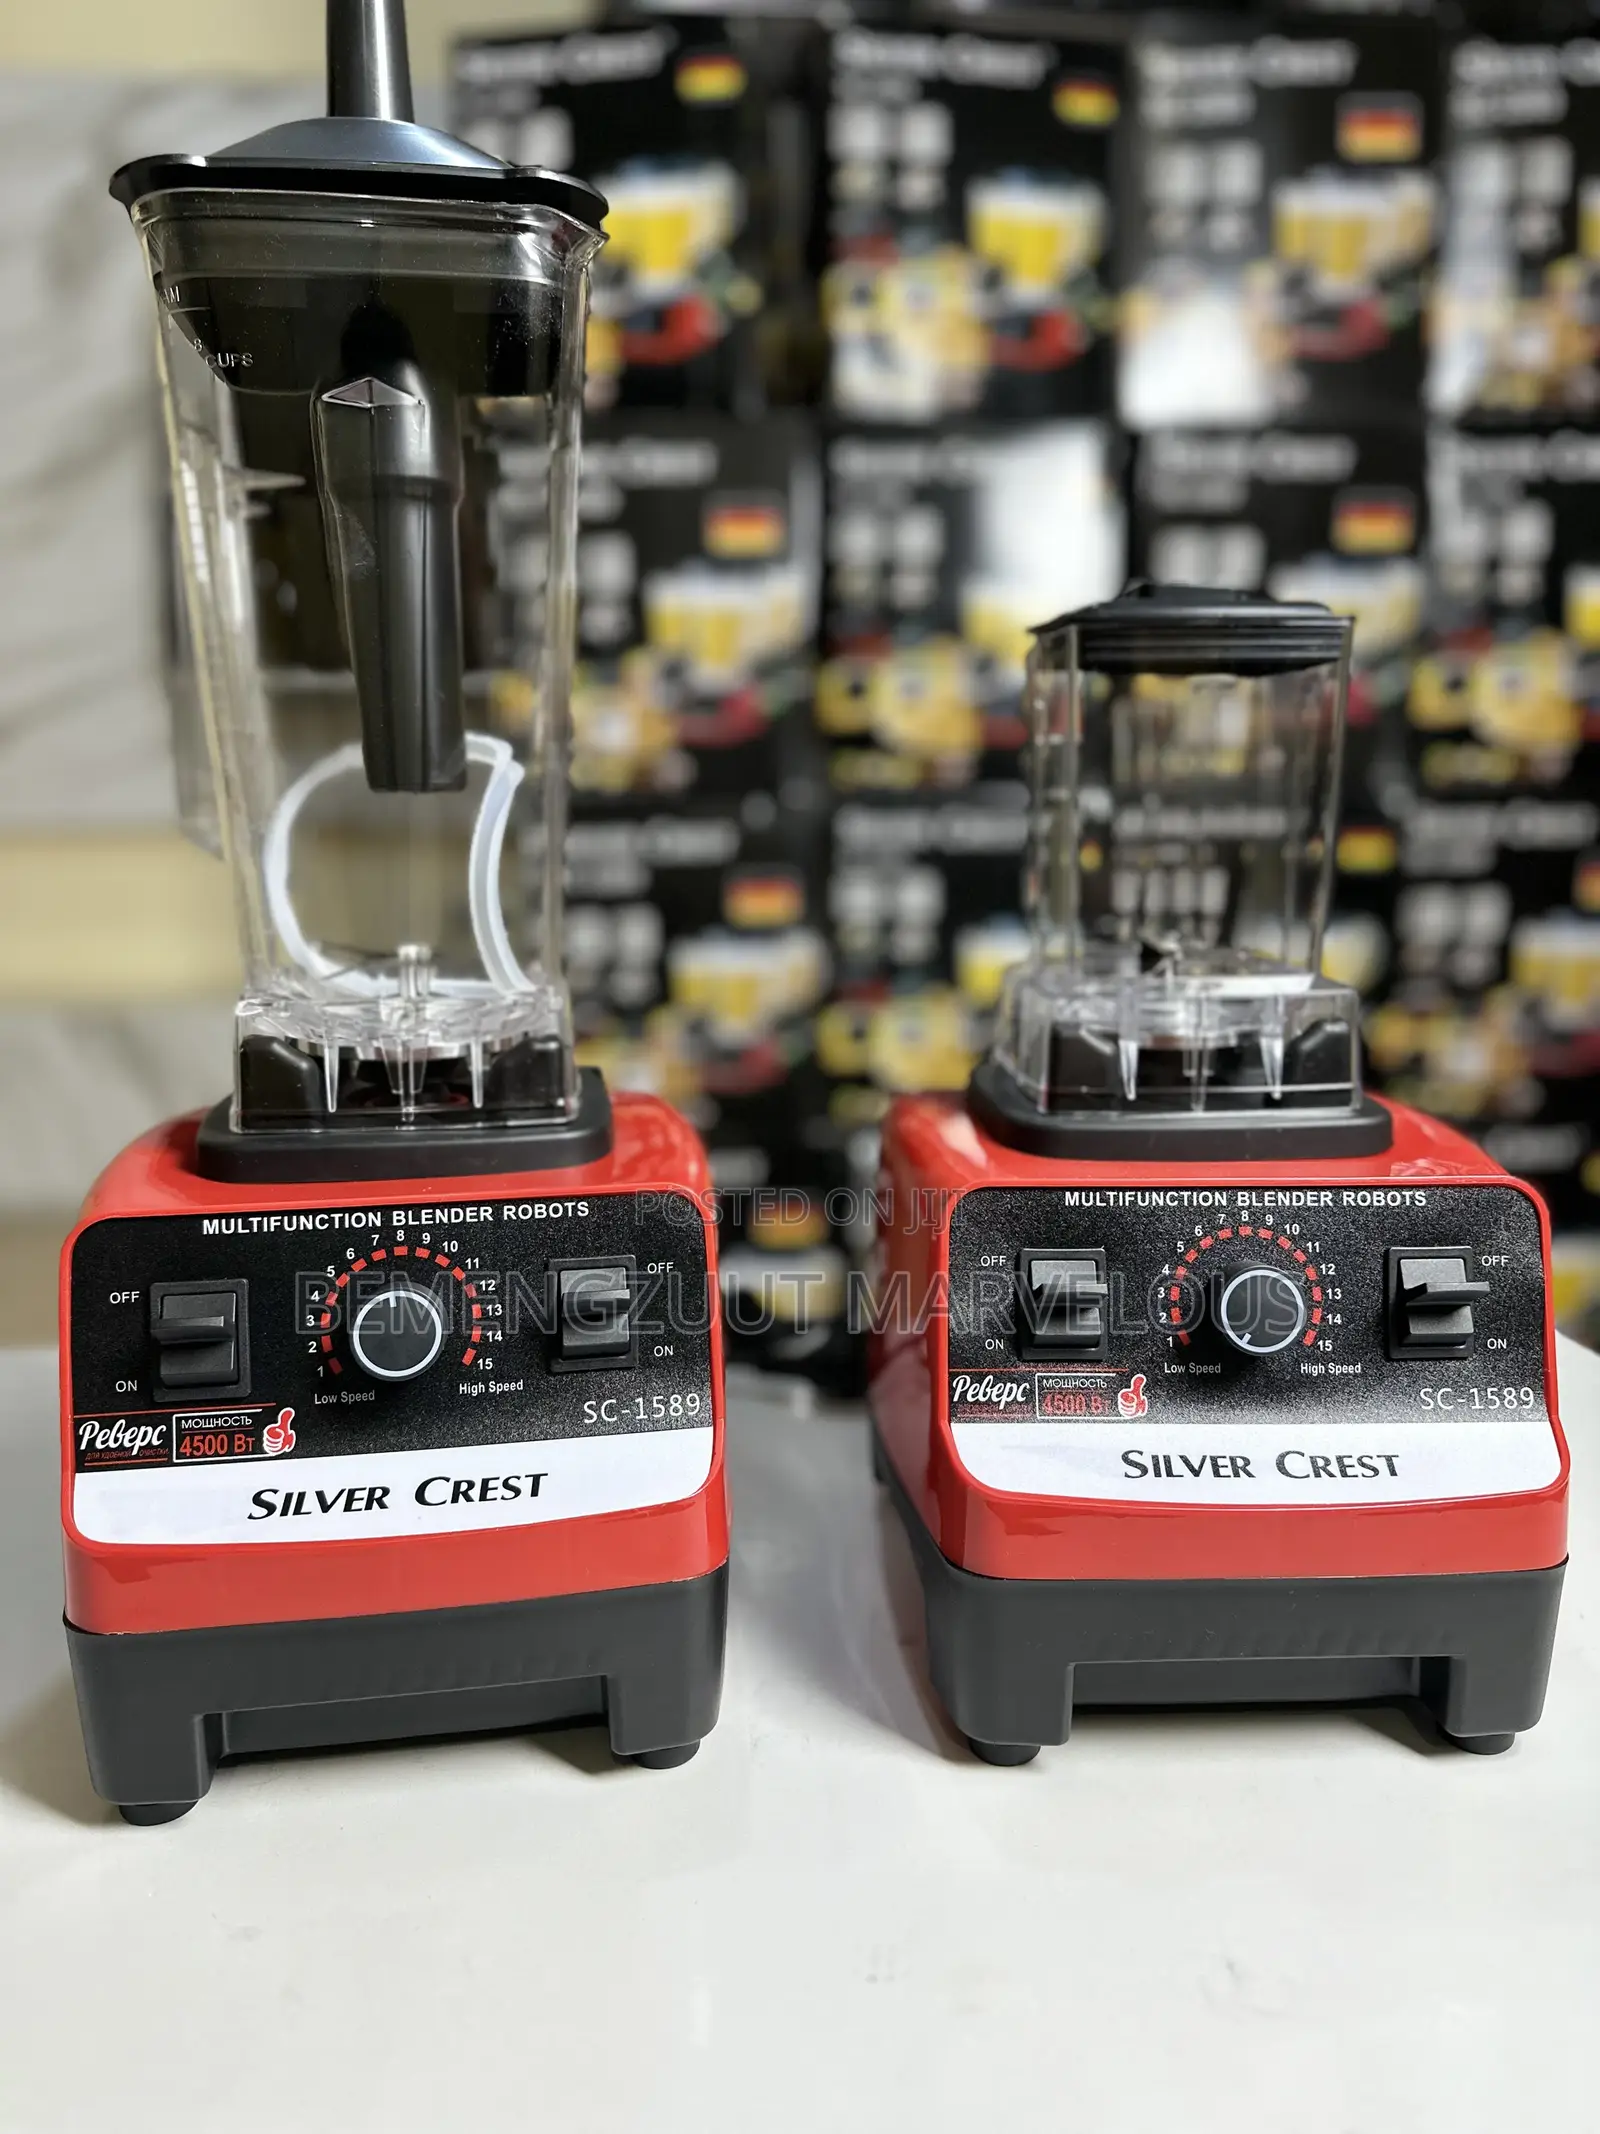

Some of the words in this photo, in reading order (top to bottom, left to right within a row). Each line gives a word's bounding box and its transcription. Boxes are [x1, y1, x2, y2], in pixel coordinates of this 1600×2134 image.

[194, 338, 203, 352] 8
[205, 352, 254, 368] CUPS
[1064, 1190, 1228, 1207] MULTIFUNCTION
[1236, 1190, 1334, 1207] BLENDER
[1342, 1190, 1427, 1207] ROBOTS
[202, 1211, 382, 1235] MULTIFUNCTION
[391, 1205, 494, 1227] BLENDER
[502, 1201, 590, 1221] ROBOTS
[1217, 1213, 1226, 1225] 7
[1241, 1210, 1249, 1221] 8
[1265, 1213, 1274, 1225] 9
[1194, 1225, 1203, 1237] 6
[1284, 1223, 1300, 1235] 10
[371, 1234, 380, 1246] 7
[396, 1230, 405, 1241] 8
[422, 1233, 431, 1244] 9
[442, 1240, 458, 1253] 10
[1176, 1241, 1184, 1253] 5
[1306, 1242, 1320, 1253] 11
[346, 1248, 355, 1260] 6
[465, 1257, 480, 1269] 11
[980, 1255, 1007, 1267] OFF
[1481, 1255, 1510, 1267] OFF
[327, 1265, 335, 1277] 5
[647, 1262, 674, 1274] OFF
[1161, 1264, 1170, 1275] 4
[1320, 1263, 1336, 1275] 12
[480, 1280, 496, 1291] 12
[109, 1291, 140, 1304] OFF
[311, 1291, 320, 1302] 4
[1157, 1287, 1166, 1298] 3
[1326, 1288, 1342, 1300] 13
[486, 1304, 503, 1316] 13
[306, 1315, 315, 1326] 3
[1159, 1312, 1167, 1324] 2
[1326, 1313, 1342, 1324] 14
[486, 1330, 503, 1342] 14
[1167, 1337, 1173, 1347] 1
[308, 1342, 317, 1353] 2
[985, 1338, 1004, 1350] ON
[1317, 1340, 1333, 1351] 15
[1487, 1338, 1507, 1349] ON
[653, 1345, 674, 1357] ON
[477, 1358, 493, 1370] 15
[1164, 1362, 1186, 1374] Low
[1188, 1362, 1221, 1376] Speed
[1300, 1362, 1325, 1375] High
[1327, 1362, 1362, 1375] Speed
[317, 1366, 324, 1377] 1
[115, 1380, 138, 1392] ON
[459, 1382, 485, 1396] High
[488, 1379, 524, 1394] Speed
[1042, 1378, 1107, 1389] МОЩНОСТЬ
[314, 1393, 338, 1404] Low
[341, 1390, 376, 1406] Speed
[953, 1374, 1030, 1410] Реверс
[1419, 1386, 1535, 1410] SC-1589
[583, 1392, 700, 1423] SC-1589
[181, 1415, 252, 1429] МОЩНОСТЬ
[79, 1419, 166, 1455] Реверс
[180, 1434, 228, 1456] 4500
[233, 1434, 256, 1453] Вт
